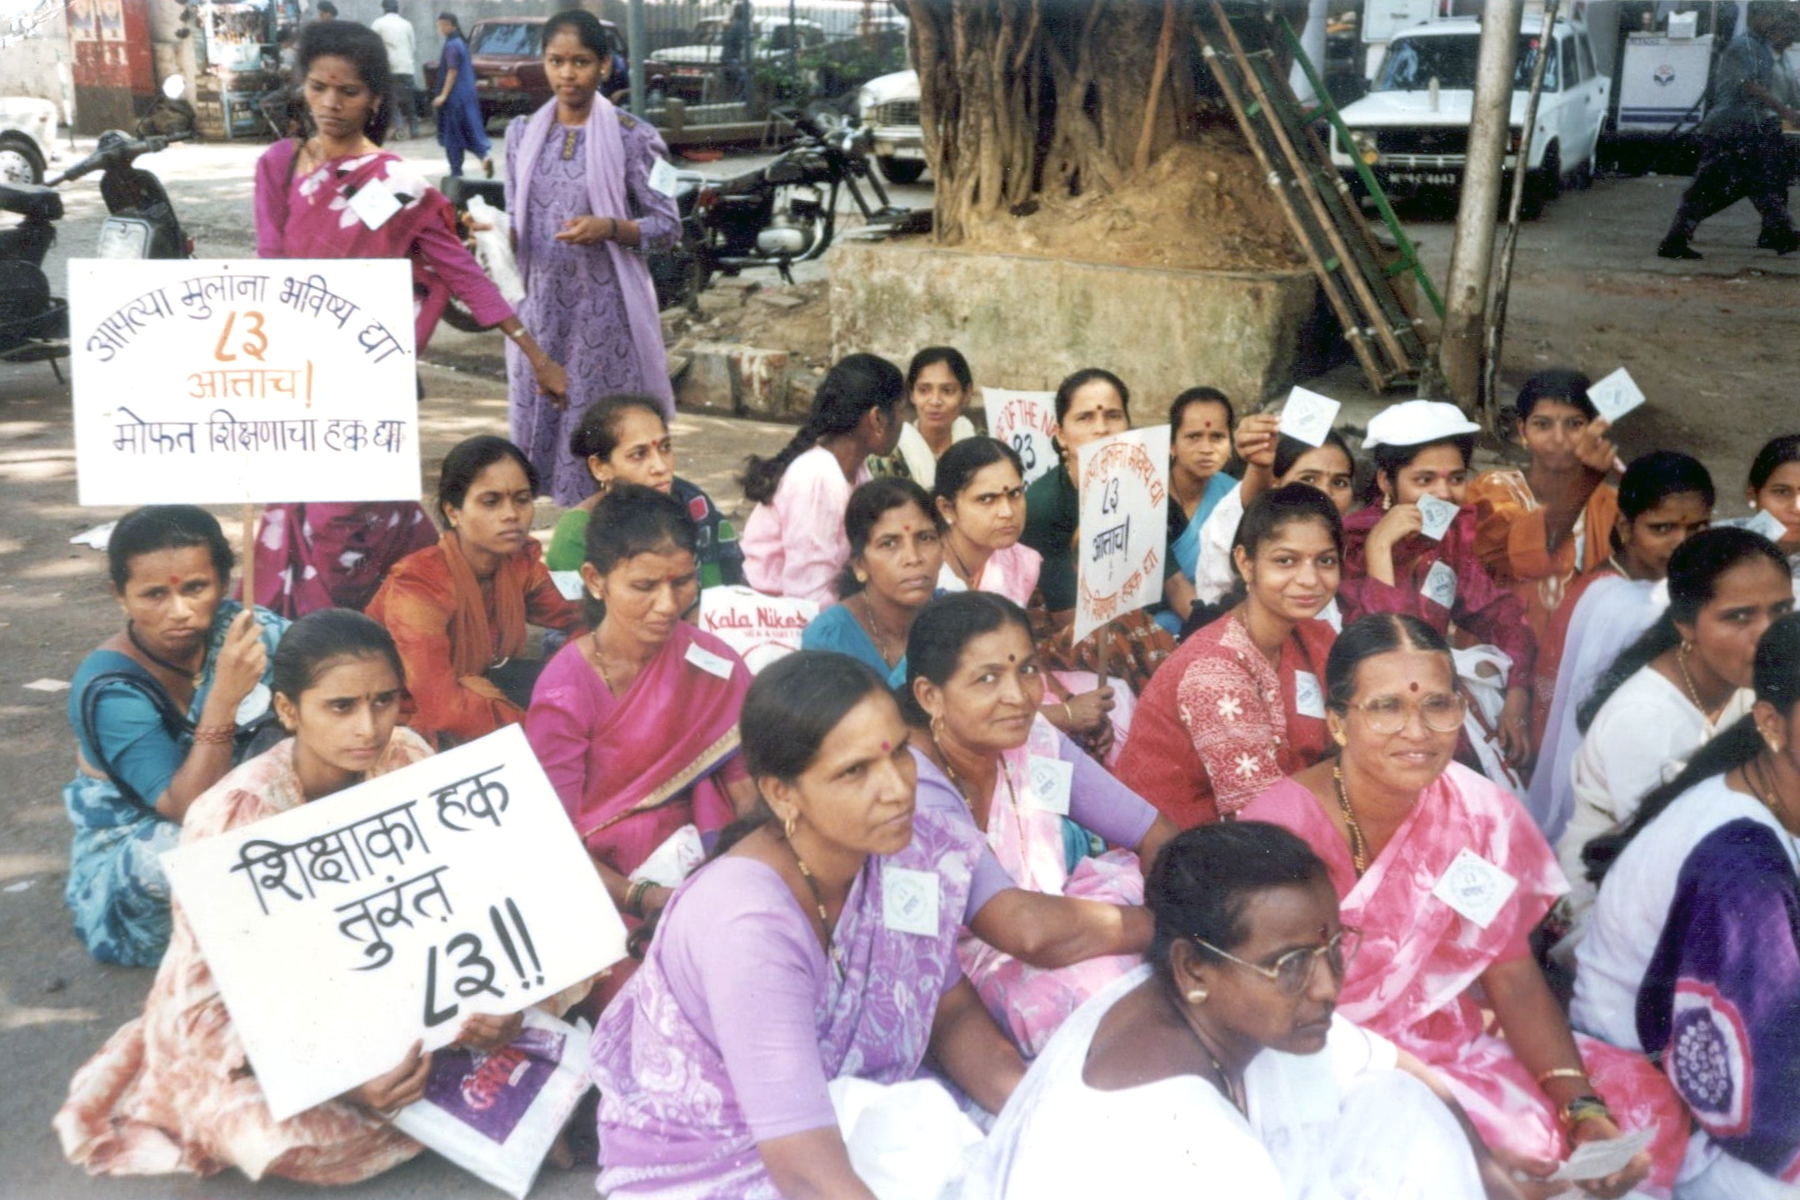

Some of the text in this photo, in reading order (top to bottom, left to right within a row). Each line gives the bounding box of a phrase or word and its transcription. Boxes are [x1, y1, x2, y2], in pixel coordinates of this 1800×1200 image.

[86, 287, 174, 363] आपल्या
[279, 274, 361, 330] भविष्य
[213, 310, 269, 362] ८३
[112, 405, 200, 455] मोफत
[1016, 399, 1038, 429] THE
[704, 606, 753, 632] Kala
[427, 763, 511, 833] हक
